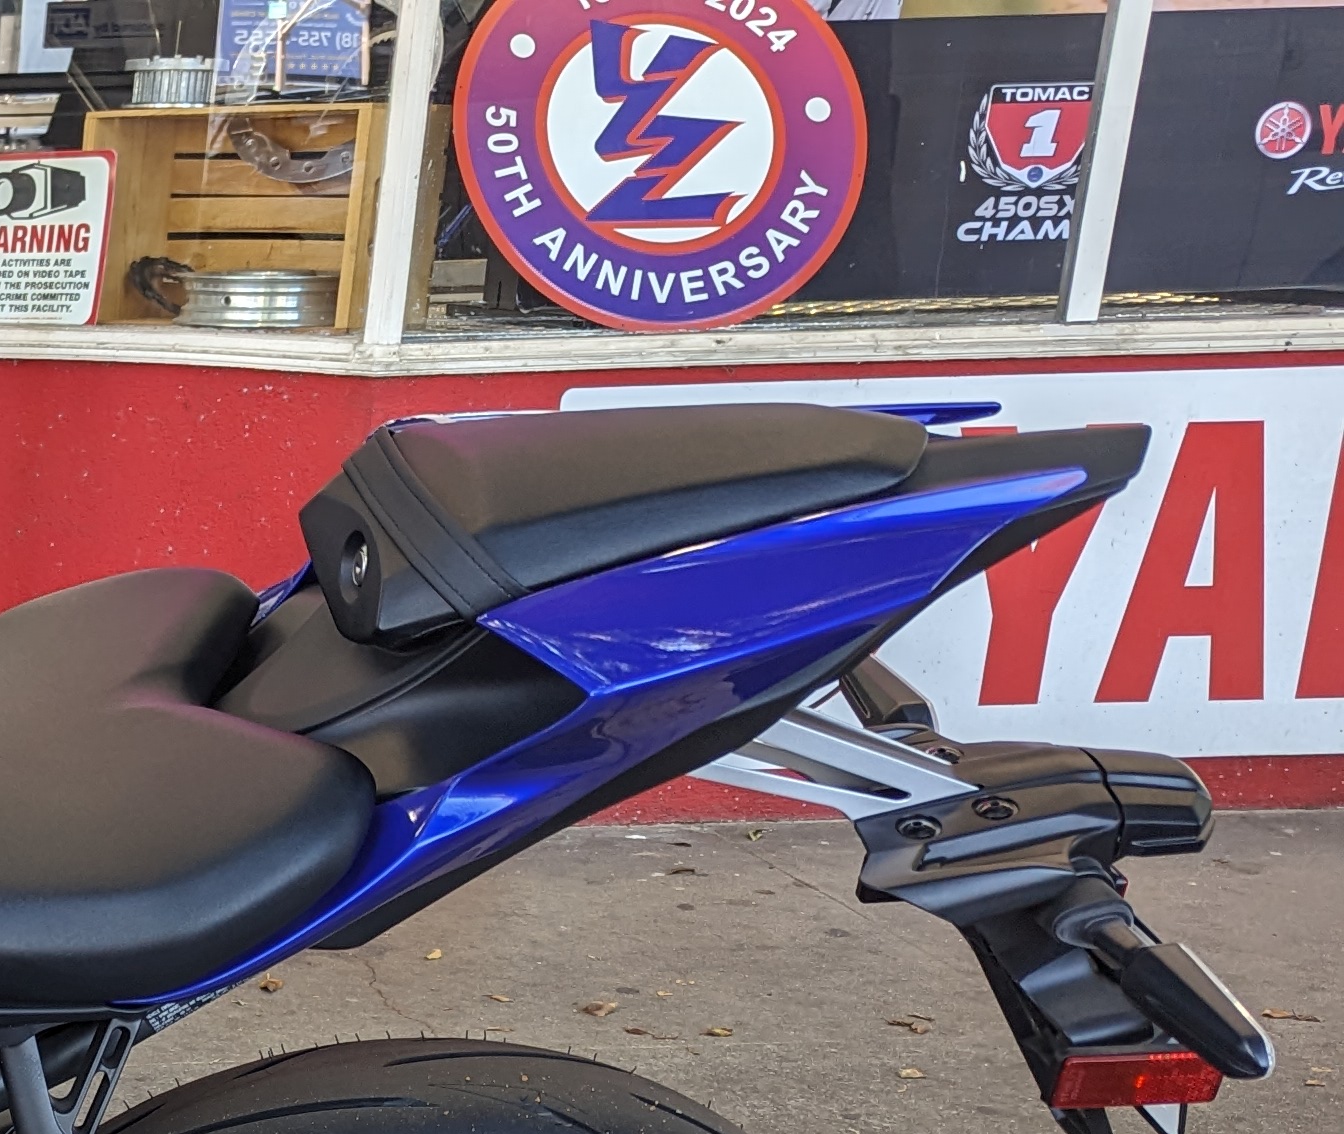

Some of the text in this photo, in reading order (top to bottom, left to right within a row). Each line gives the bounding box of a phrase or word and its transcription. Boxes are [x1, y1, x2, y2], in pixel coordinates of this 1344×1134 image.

[1001, 86, 1090, 102] TOMAC
[1018, 109, 1063, 158] 1
[1319, 103, 1344, 155] Y
[485, 104, 543, 218] 50TH
[532, 170, 830, 304] ANNIVERSARY
[1, 258, 51, 268] ACTIVITIES
[53, 258, 72, 268] ARE
[16, 269, 30, 279] ON
[32, 269, 60, 279] VIDEO
[63, 269, 87, 279] TAPE
[4, 281, 21, 290] THE
[24, 280, 90, 290] PROSECUTION
[0, 292, 28, 302] CRIME
[30, 292, 80, 302] COMMITTED
[9, 303, 28, 313] THIS
[30, 303, 73, 313] FACILITY.
[960, 420, 1344, 705] YA
